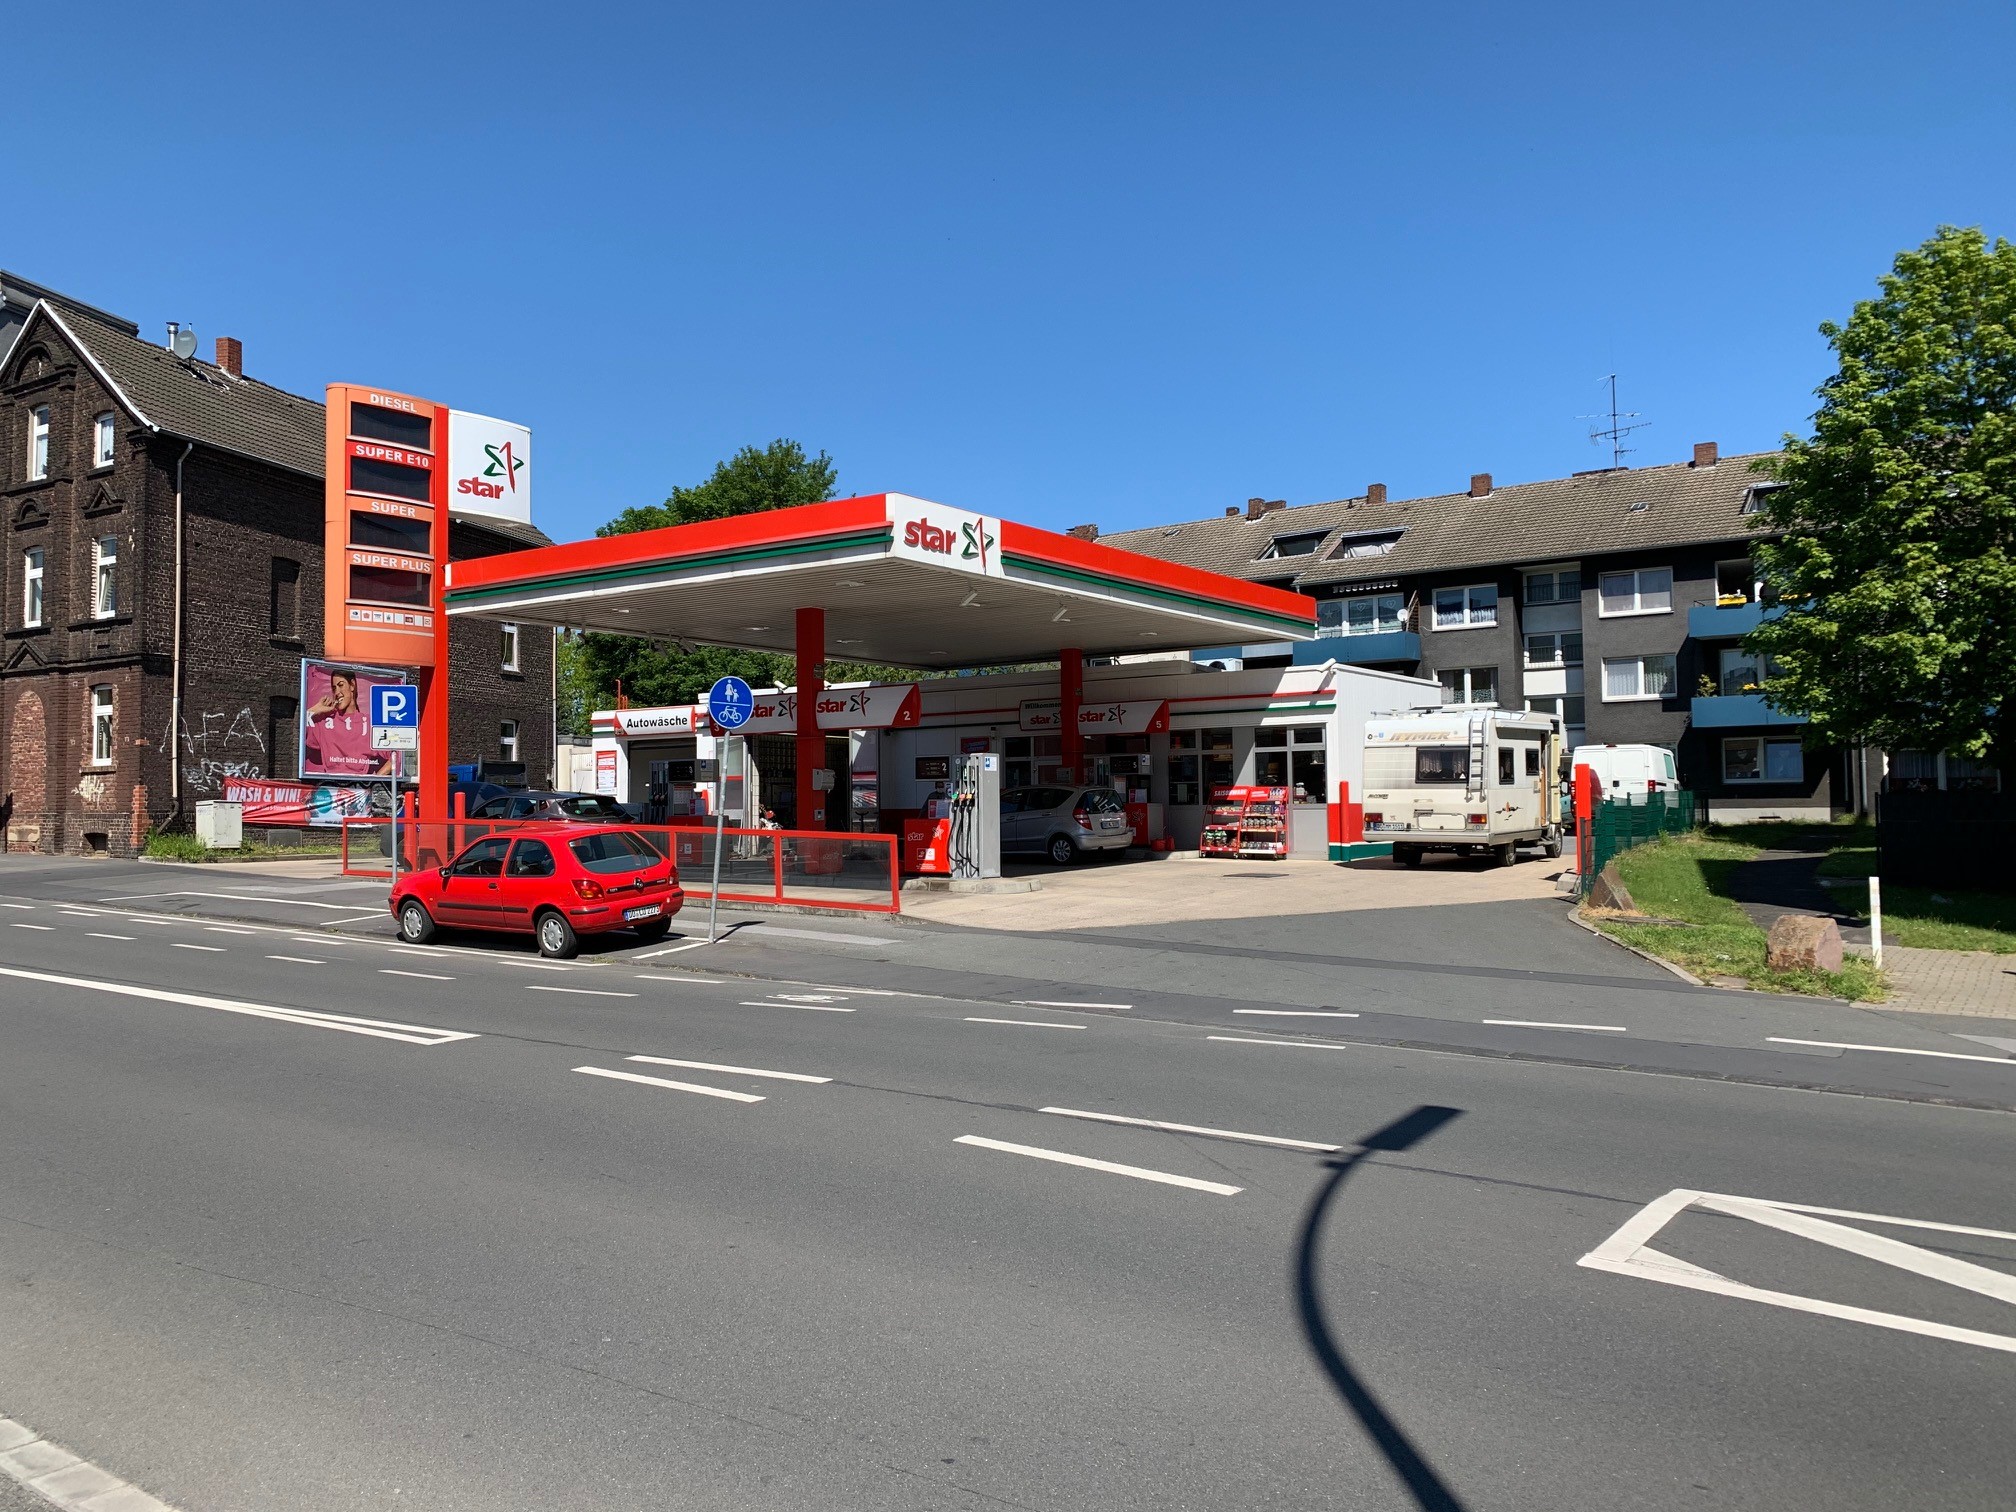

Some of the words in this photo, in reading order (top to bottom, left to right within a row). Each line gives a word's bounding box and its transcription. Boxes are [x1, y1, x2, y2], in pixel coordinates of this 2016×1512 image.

[370, 393, 417, 413] DIESEL
[356, 444, 403, 462] SUPER
[407, 453, 429, 467] E10
[457, 477, 504, 499] star
[371, 501, 416, 517] SUPER
[904, 517, 956, 554] star
[352, 553, 397, 567] SUPER
[401, 559, 431, 572] PLUS
[382, 691, 406, 723] P
[816, 698, 847, 713] star
[306, 710, 369, 736] Katj
[626, 715, 688, 728] Autowäsche
[903, 711, 911, 720] 2
[1030, 714, 1051, 725] star
[1079, 710, 1106, 723] star
[713, 724, 720, 732] 3
[1155, 720, 1162, 728] 5
[226, 787, 262, 802] WASH
[263, 789, 272, 802] &
[274, 788, 300, 803] WIN!
